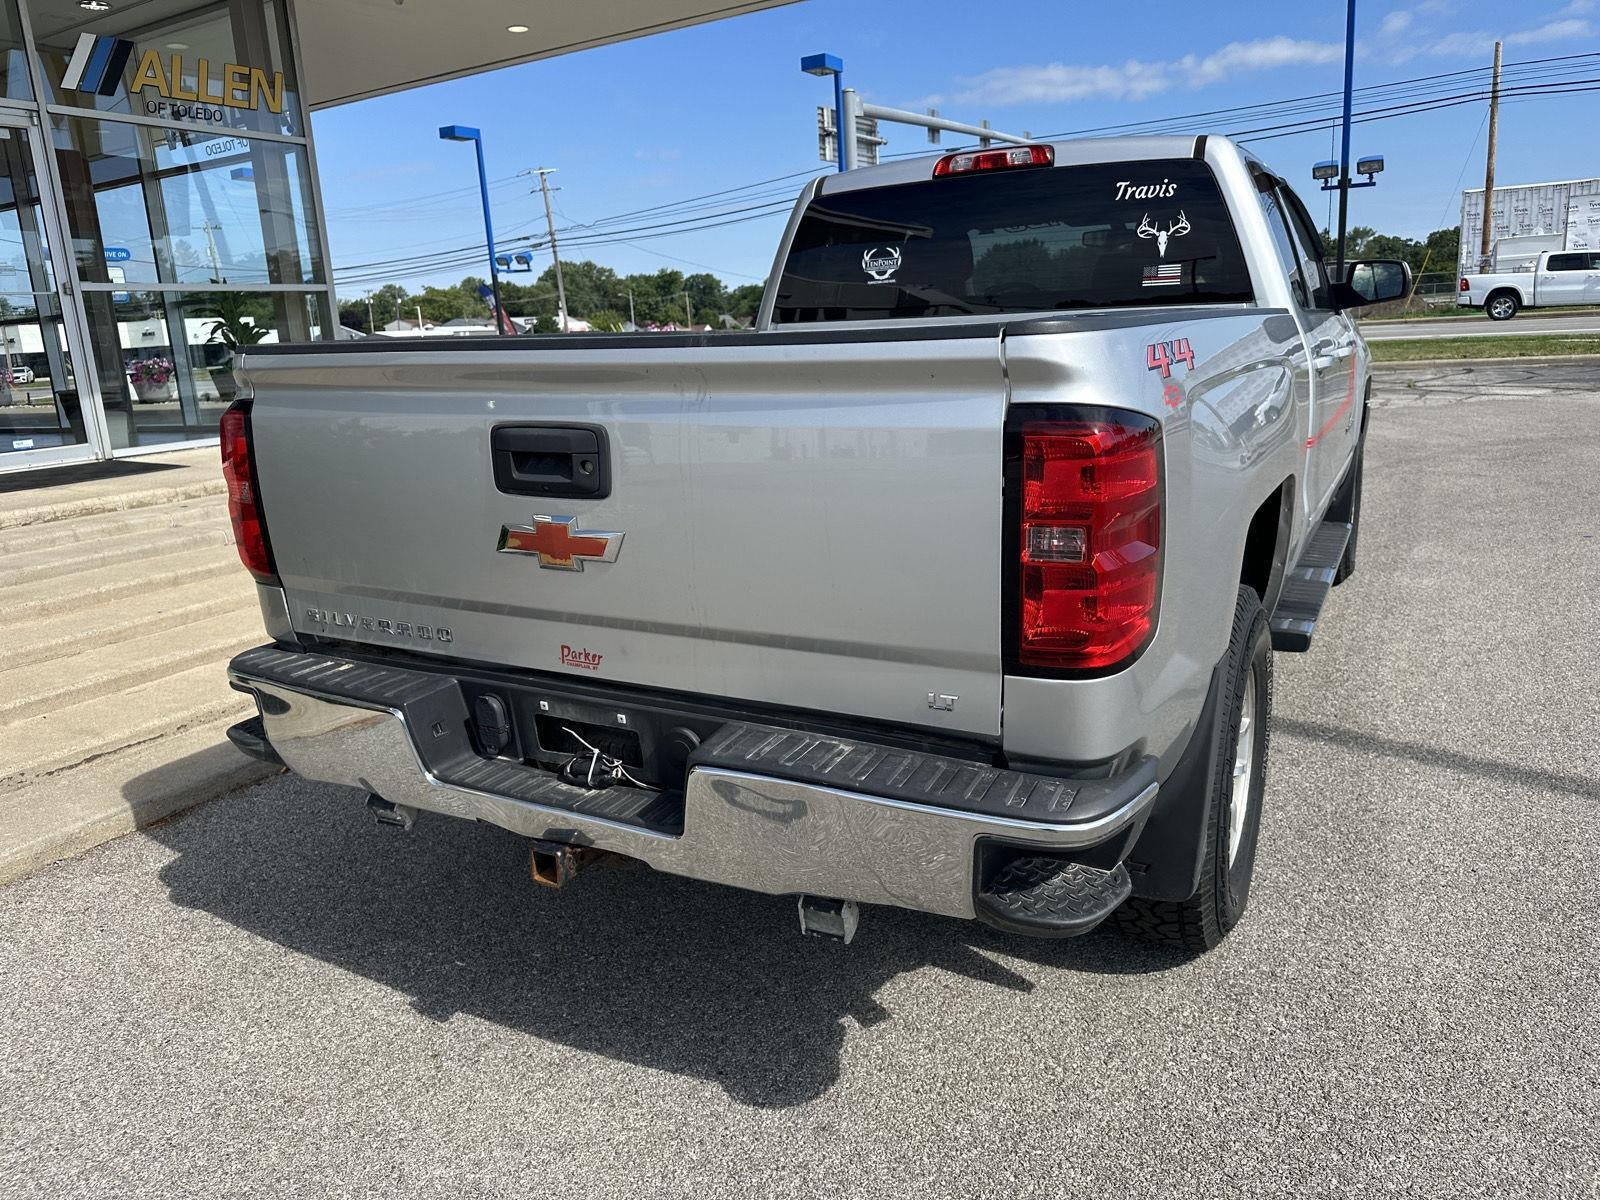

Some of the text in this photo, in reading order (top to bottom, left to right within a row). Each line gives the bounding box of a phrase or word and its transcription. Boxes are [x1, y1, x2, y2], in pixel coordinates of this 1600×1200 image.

[130, 49, 283, 113] ALLEN
[146, 100, 223, 122] OF TOLEDO
[1115, 178, 1178, 201] Travis
[306, 607, 453, 642] SILVERADO
[560, 644, 603, 665] Parker
[928, 691, 960, 712] LT
